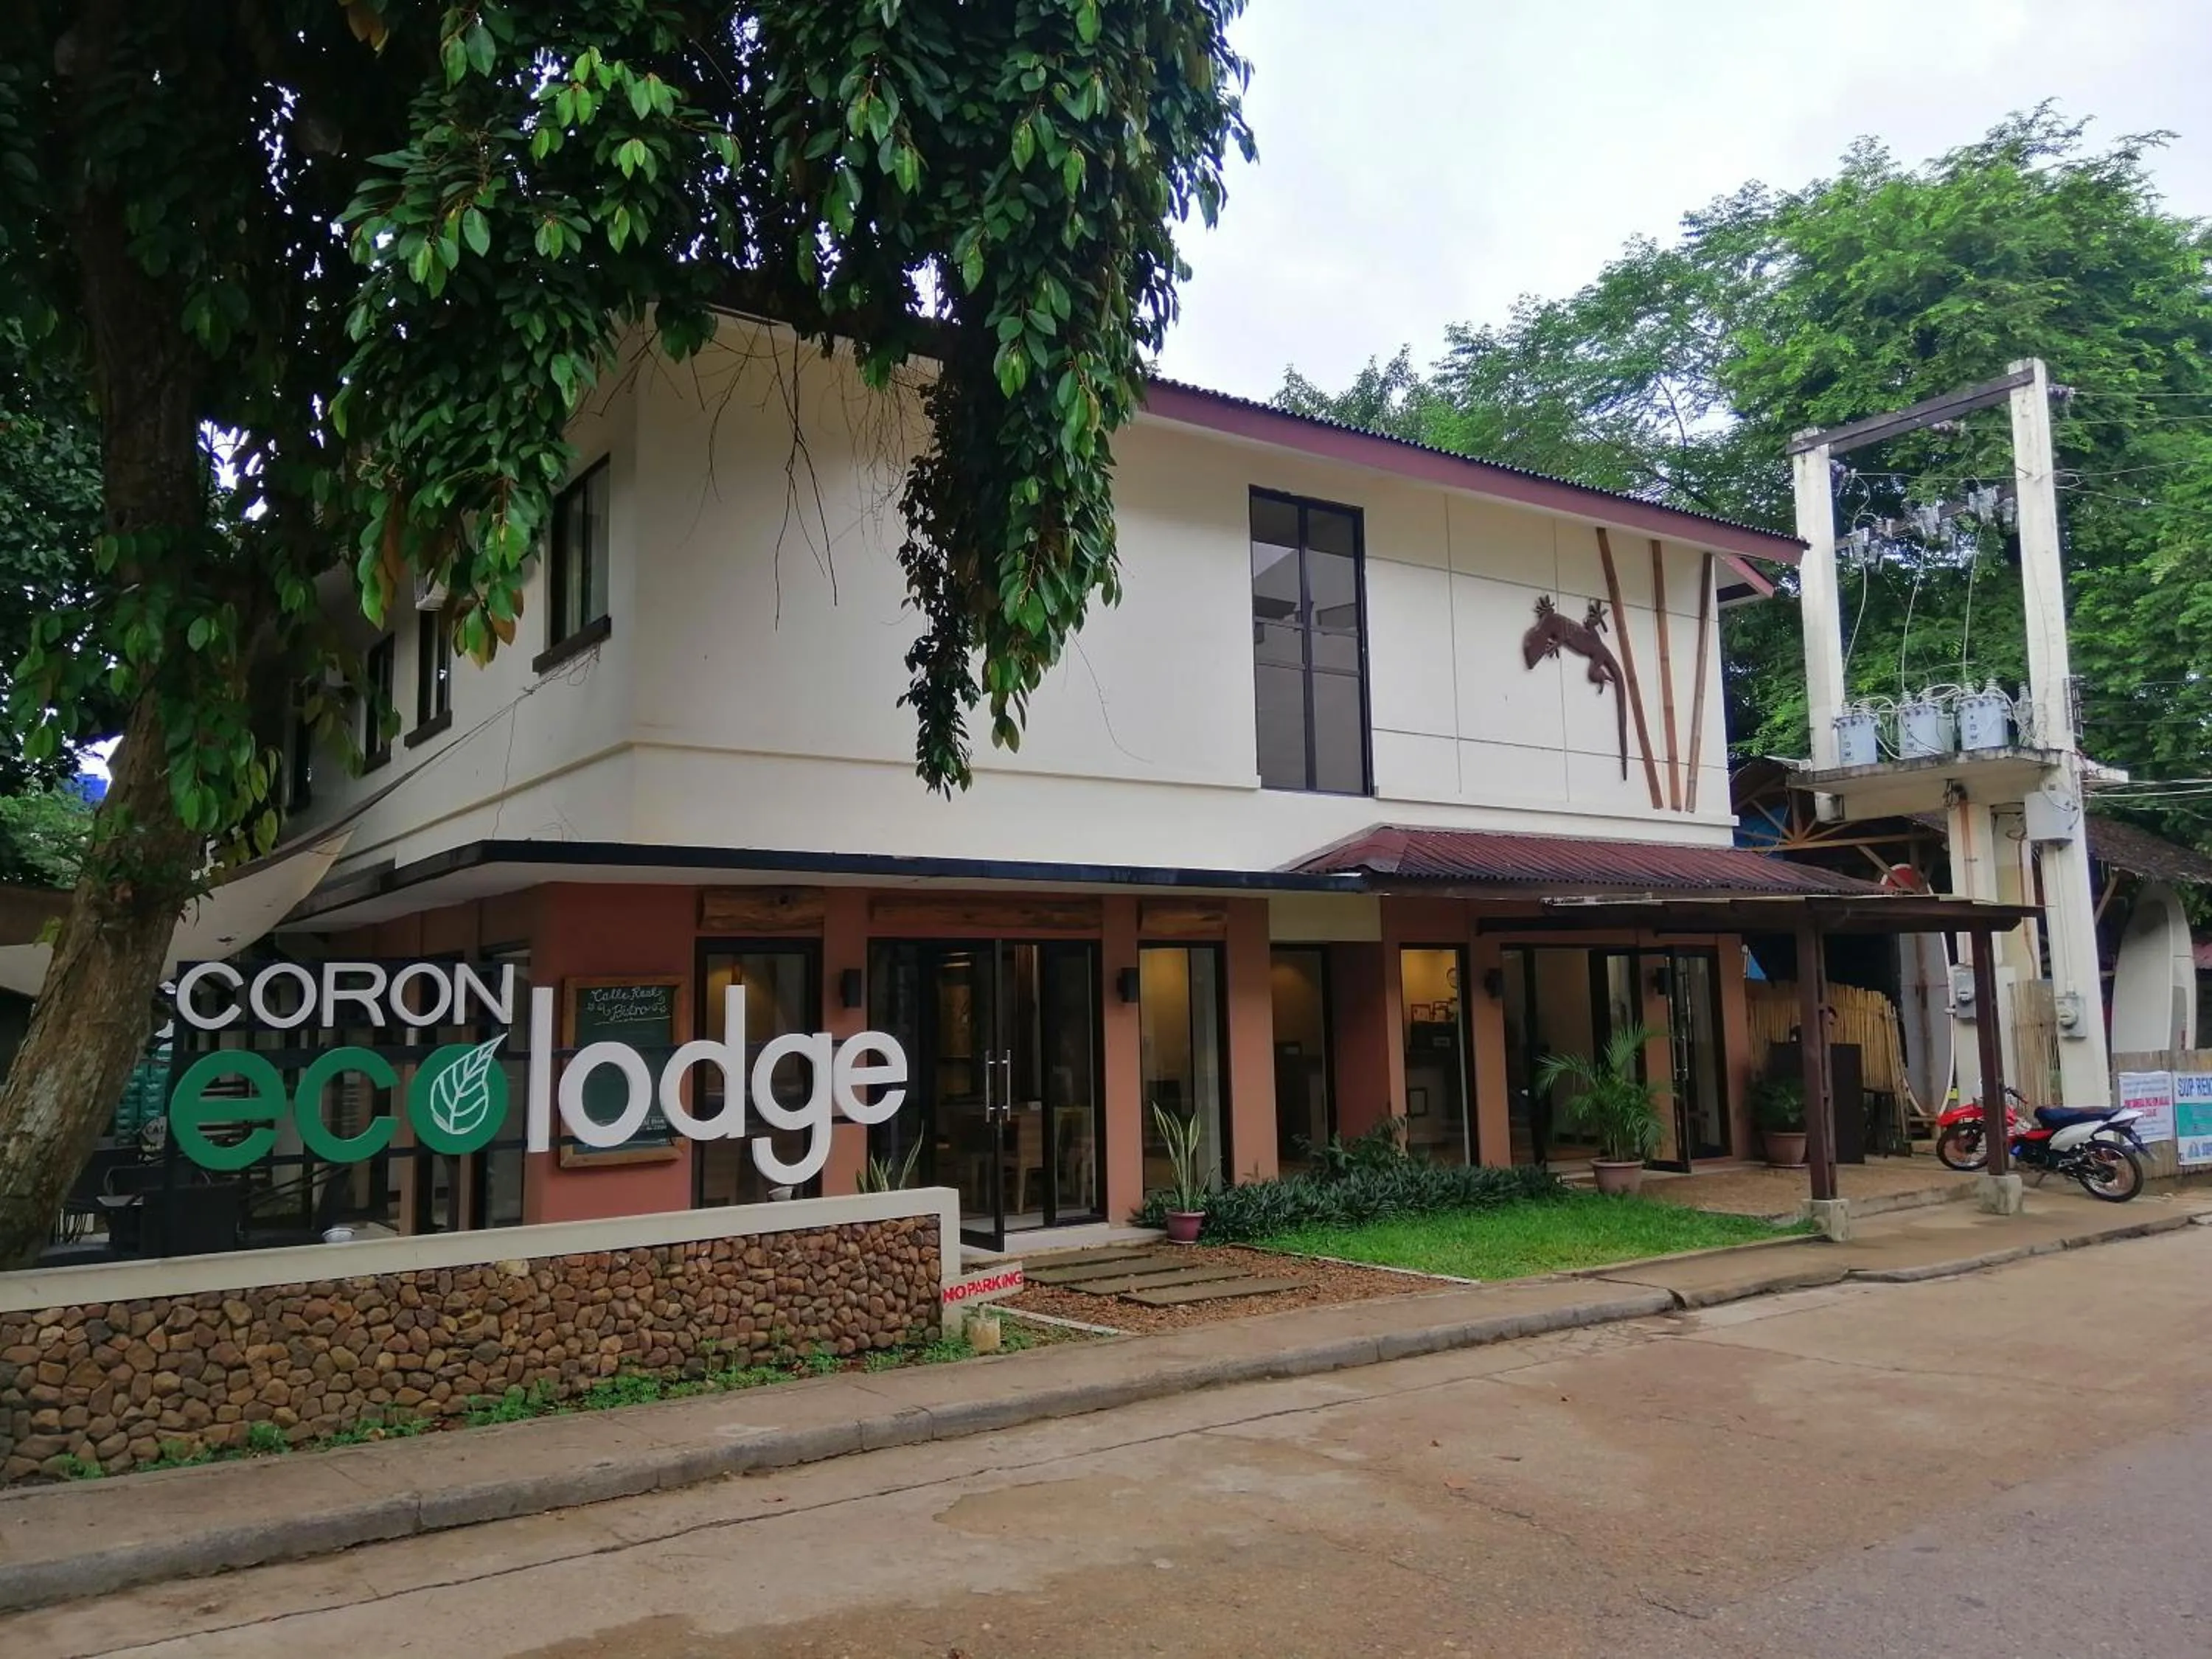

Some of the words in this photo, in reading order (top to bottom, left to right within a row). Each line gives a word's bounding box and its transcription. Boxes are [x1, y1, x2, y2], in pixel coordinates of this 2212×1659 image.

[176, 961, 515, 1030] CORON
[591, 988, 627, 1002] Calle
[170, 1040, 509, 1170] eco
[526, 984, 908, 1186] lodge
[2195, 1077, 2212, 1096] REN
[943, 1285, 967, 1304] NO
[967, 1270, 1023, 1297] PARKING
